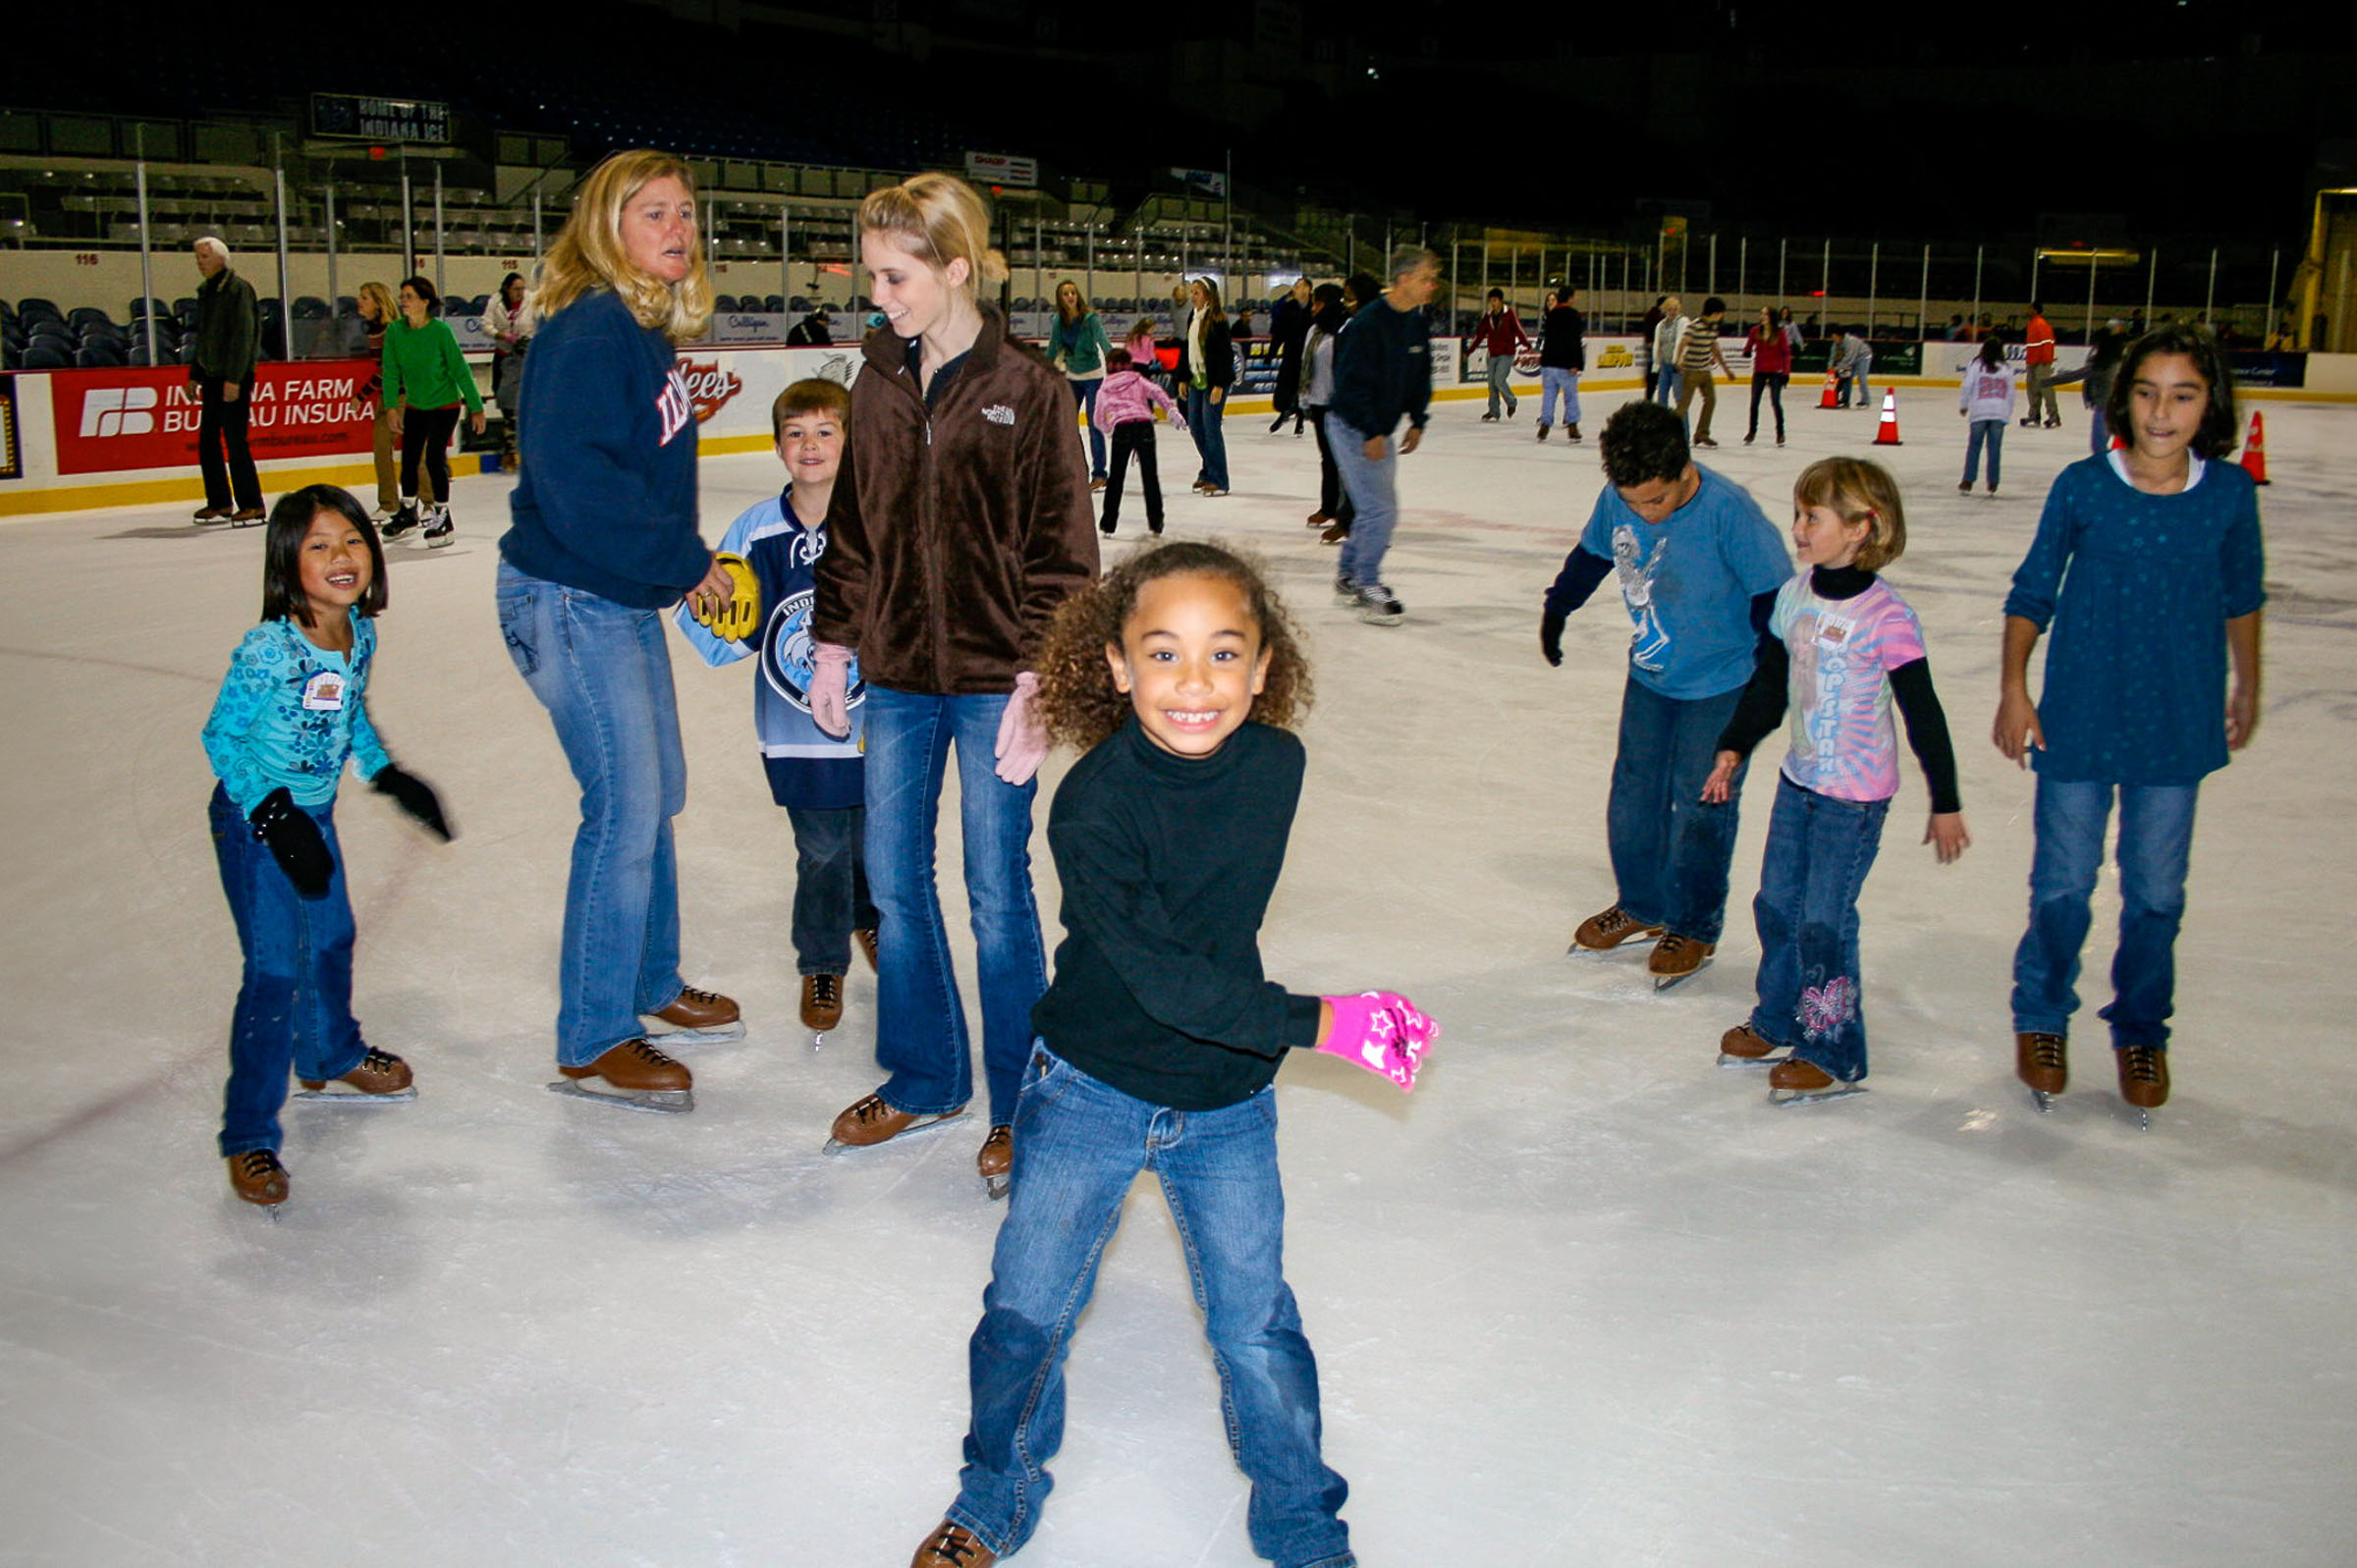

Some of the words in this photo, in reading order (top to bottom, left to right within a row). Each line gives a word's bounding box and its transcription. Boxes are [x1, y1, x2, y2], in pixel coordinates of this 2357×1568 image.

[359, 118, 418, 139] INDIANA
[424, 123, 445, 141] ICE
[284, 378, 353, 402] FARM
